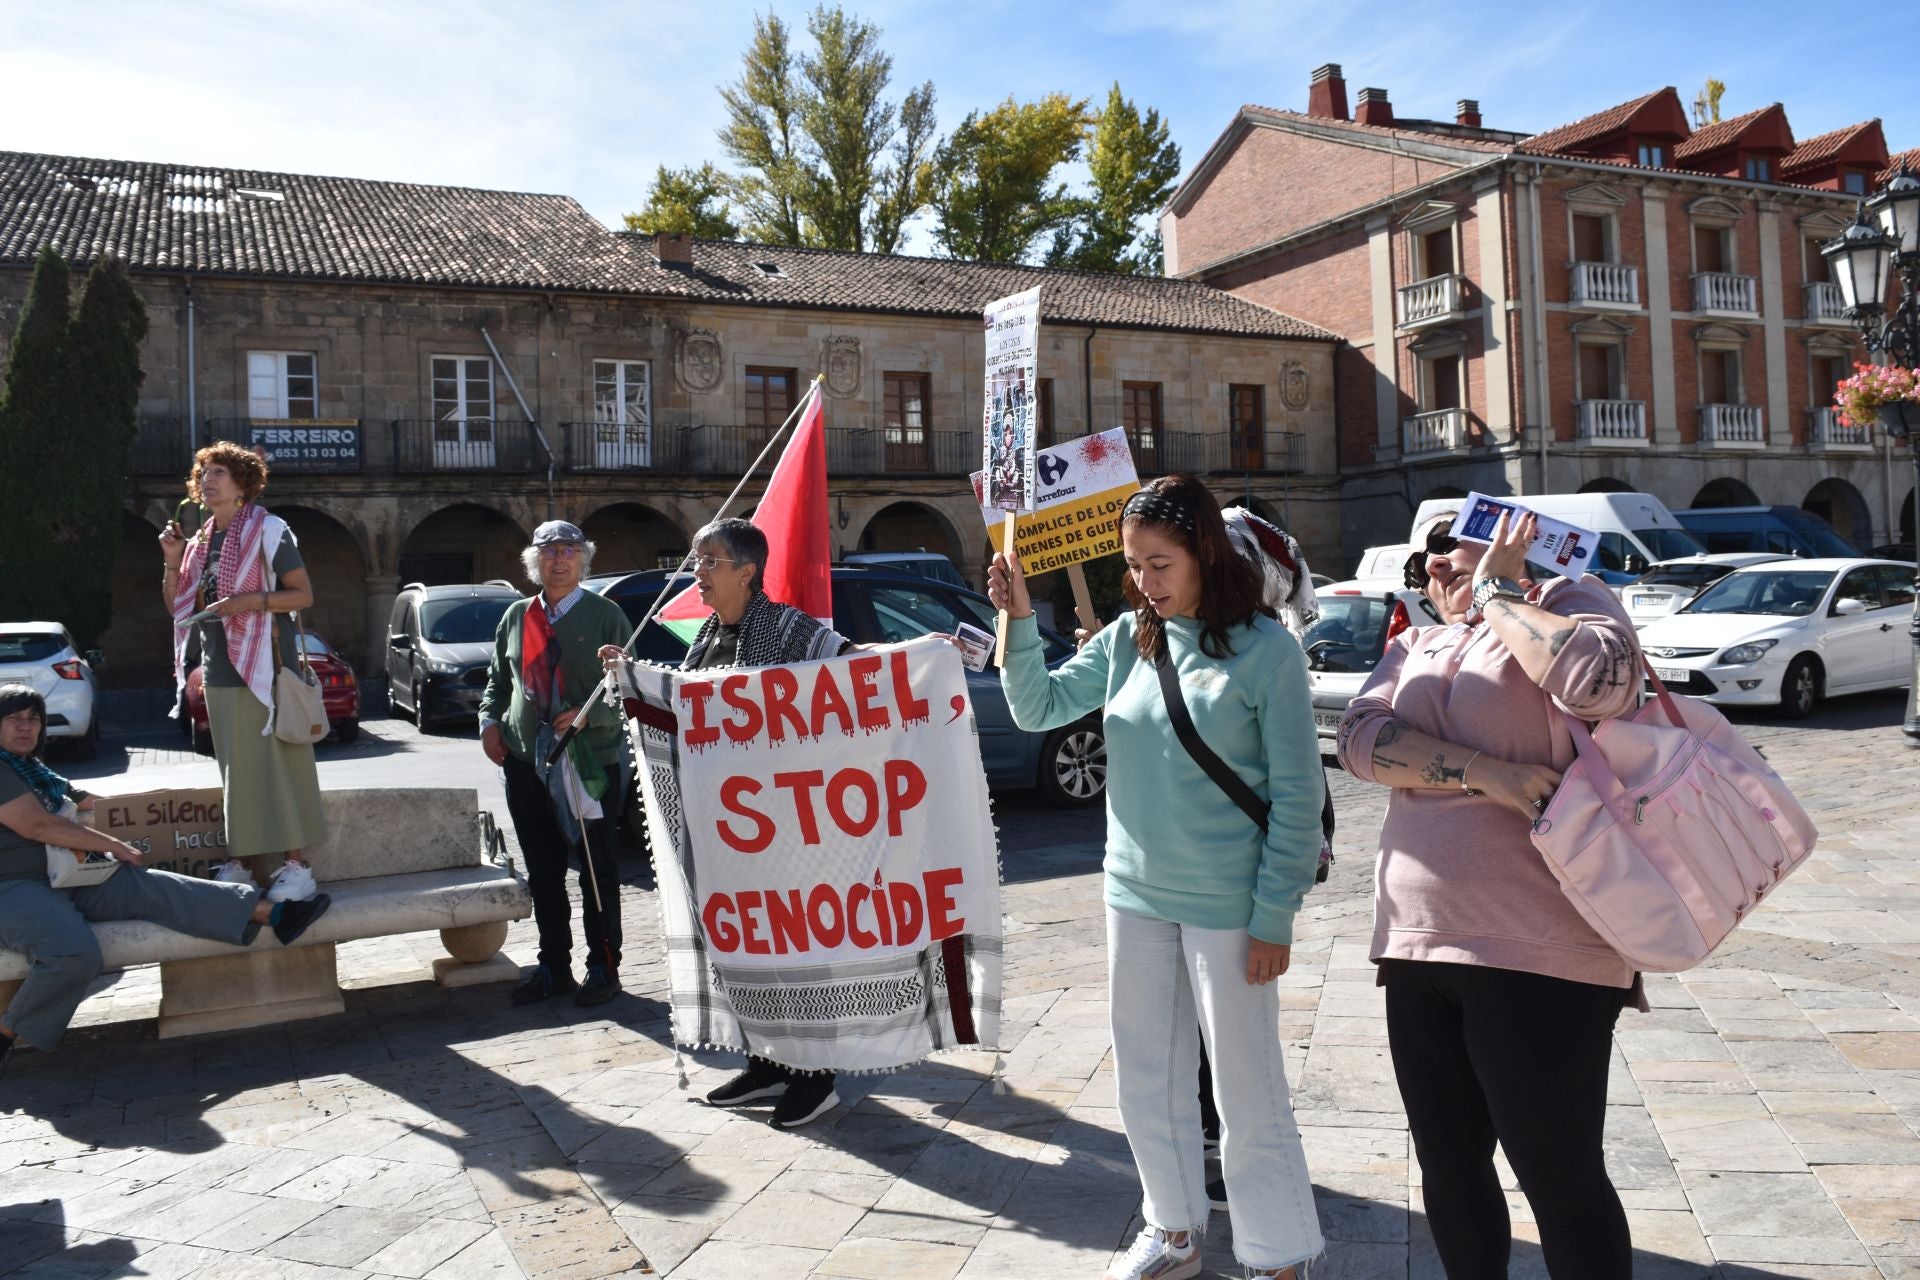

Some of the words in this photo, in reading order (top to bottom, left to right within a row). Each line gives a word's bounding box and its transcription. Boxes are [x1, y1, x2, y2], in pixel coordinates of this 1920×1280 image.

[275, 448, 299, 458] 653
[302, 448, 318, 458] 13
[321, 448, 337, 458] 03
[340, 448, 356, 458] 04
[1037, 485, 1077, 504] arrefour
[1015, 514, 1074, 541] ÓMPLICE
[1076, 507, 1095, 521] DE
[1097, 498, 1124, 516] LOS
[1015, 535, 1063, 559] ÍMENES
[1065, 529, 1084, 545] DE
[1031, 546, 1091, 573] RÉGIMEN
[108, 807, 136, 828] EL
[716, 759, 928, 854] STOP
